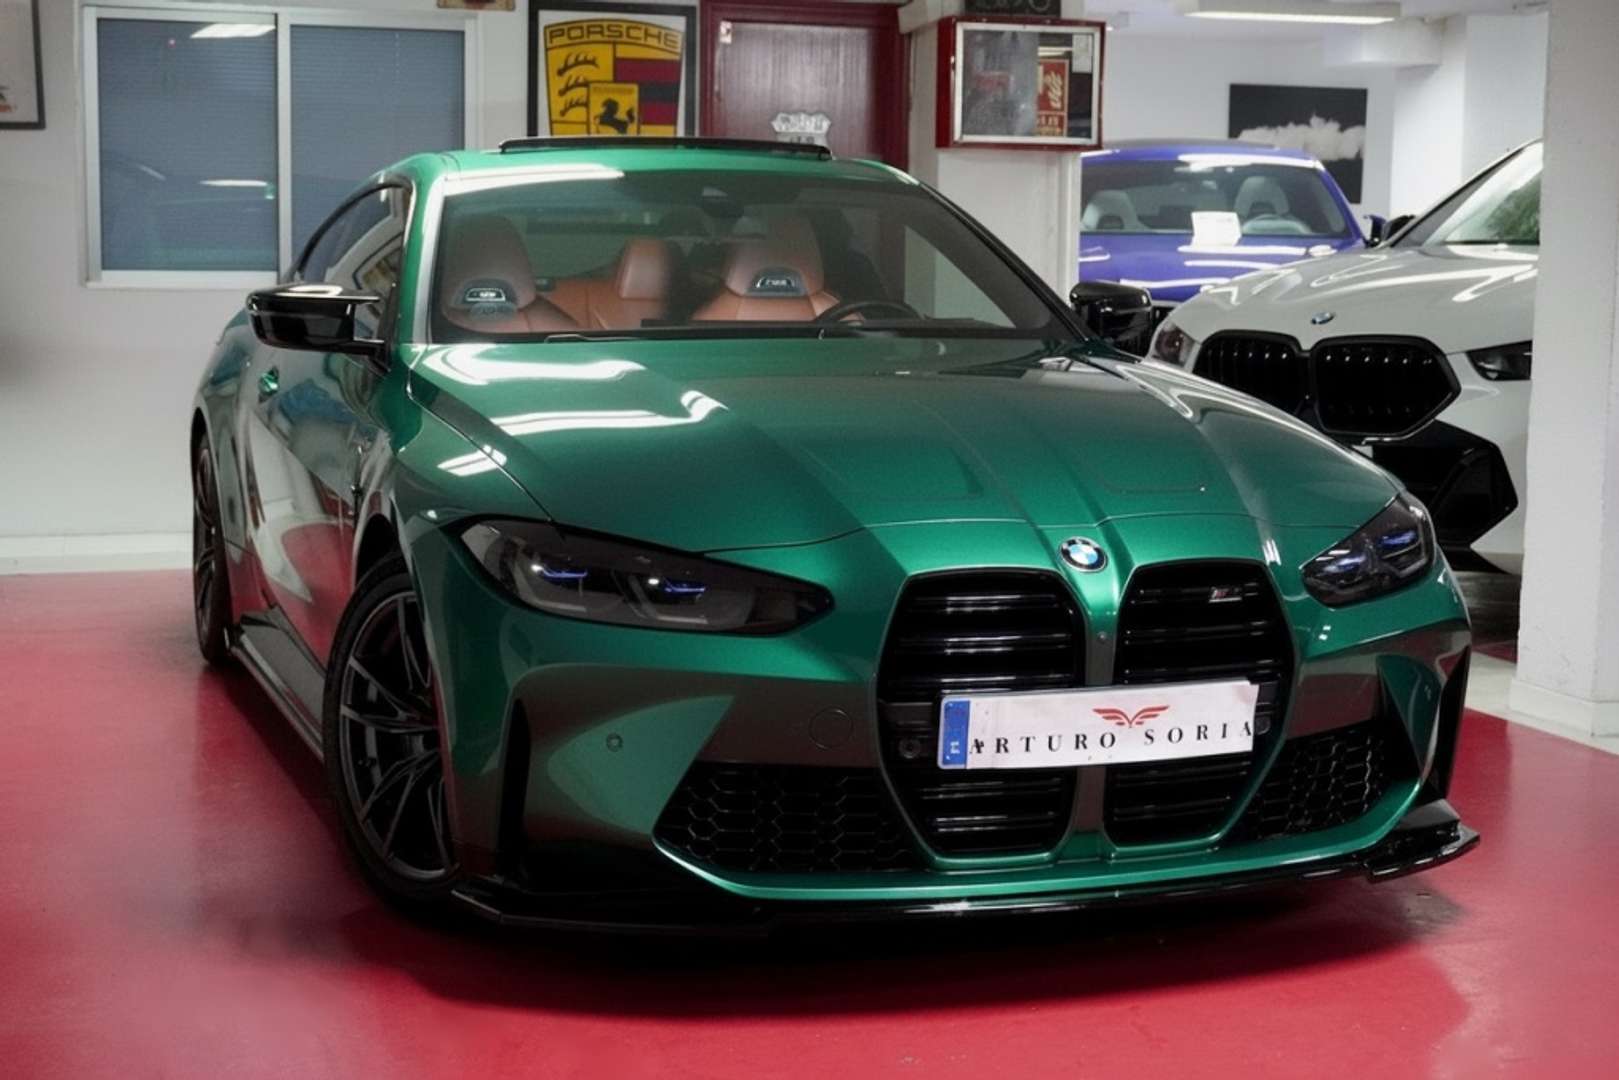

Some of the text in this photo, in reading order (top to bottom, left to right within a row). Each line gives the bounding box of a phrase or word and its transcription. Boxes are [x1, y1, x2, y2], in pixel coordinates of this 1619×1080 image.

[549, 24, 679, 48] PORSCHE
[970, 721, 1252, 754] ARTURO SORIA
